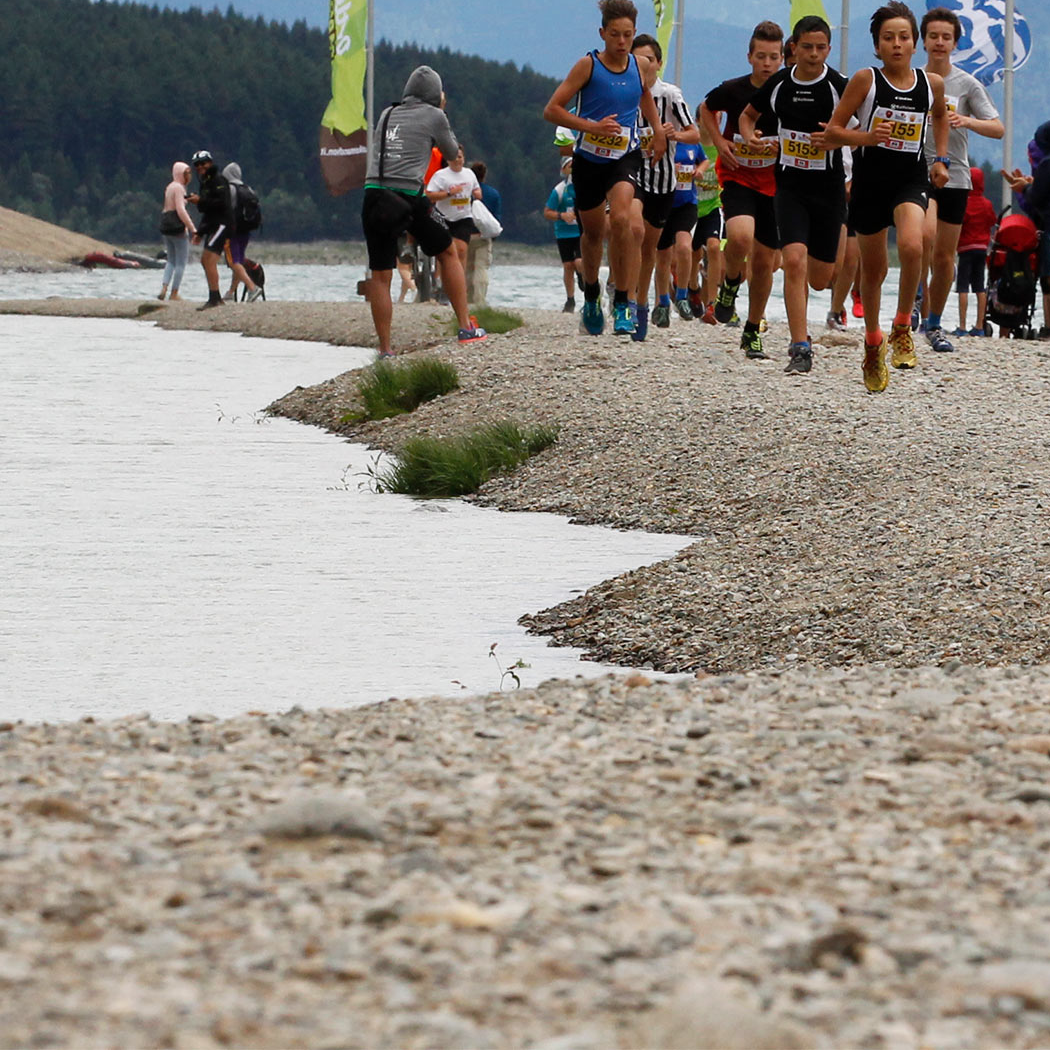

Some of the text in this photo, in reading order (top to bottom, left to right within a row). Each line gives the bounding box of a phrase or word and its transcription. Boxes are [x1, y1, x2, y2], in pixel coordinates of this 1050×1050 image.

[882, 119, 916, 137] 155
[740, 144, 772, 157] 52
[788, 140, 819, 157] 5153
